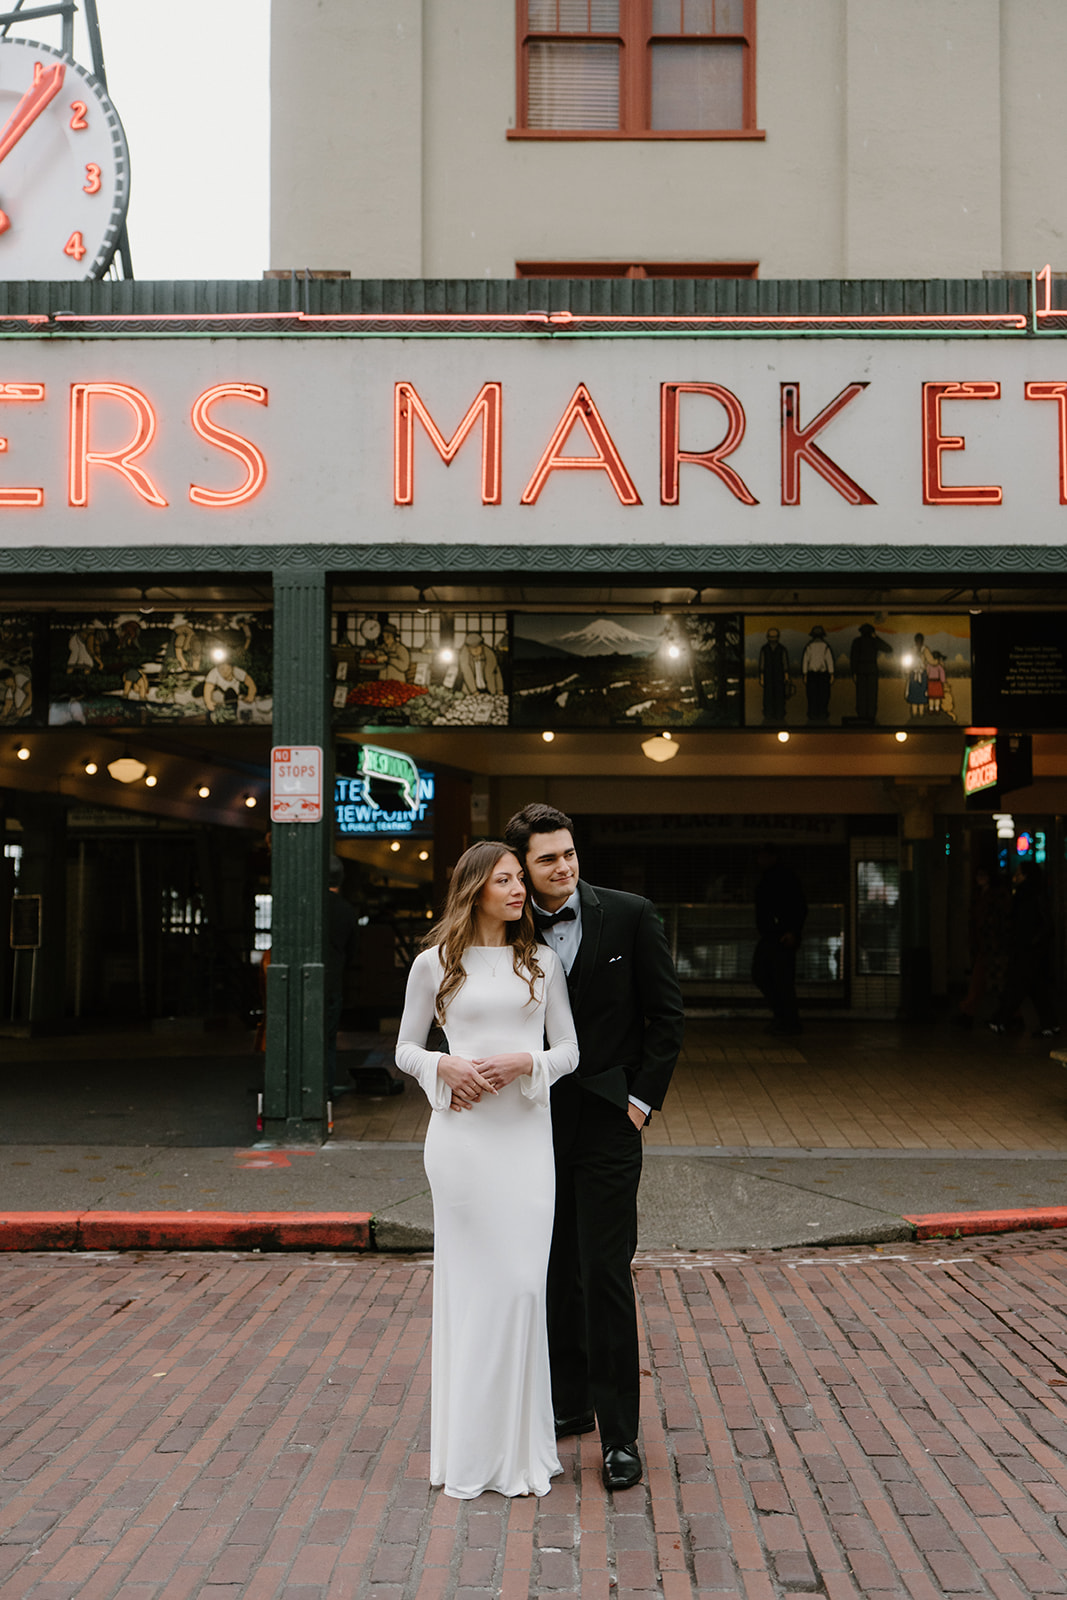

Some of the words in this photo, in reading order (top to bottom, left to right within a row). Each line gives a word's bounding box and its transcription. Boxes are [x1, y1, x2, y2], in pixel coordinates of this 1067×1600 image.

[69, 100, 89, 131] 2
[82, 162, 102, 195] 3
[63, 230, 87, 262] 4
[275, 750, 289, 761] NO
[278, 765, 316, 778] STOPS
[335, 803, 428, 823] IEWPOINT
